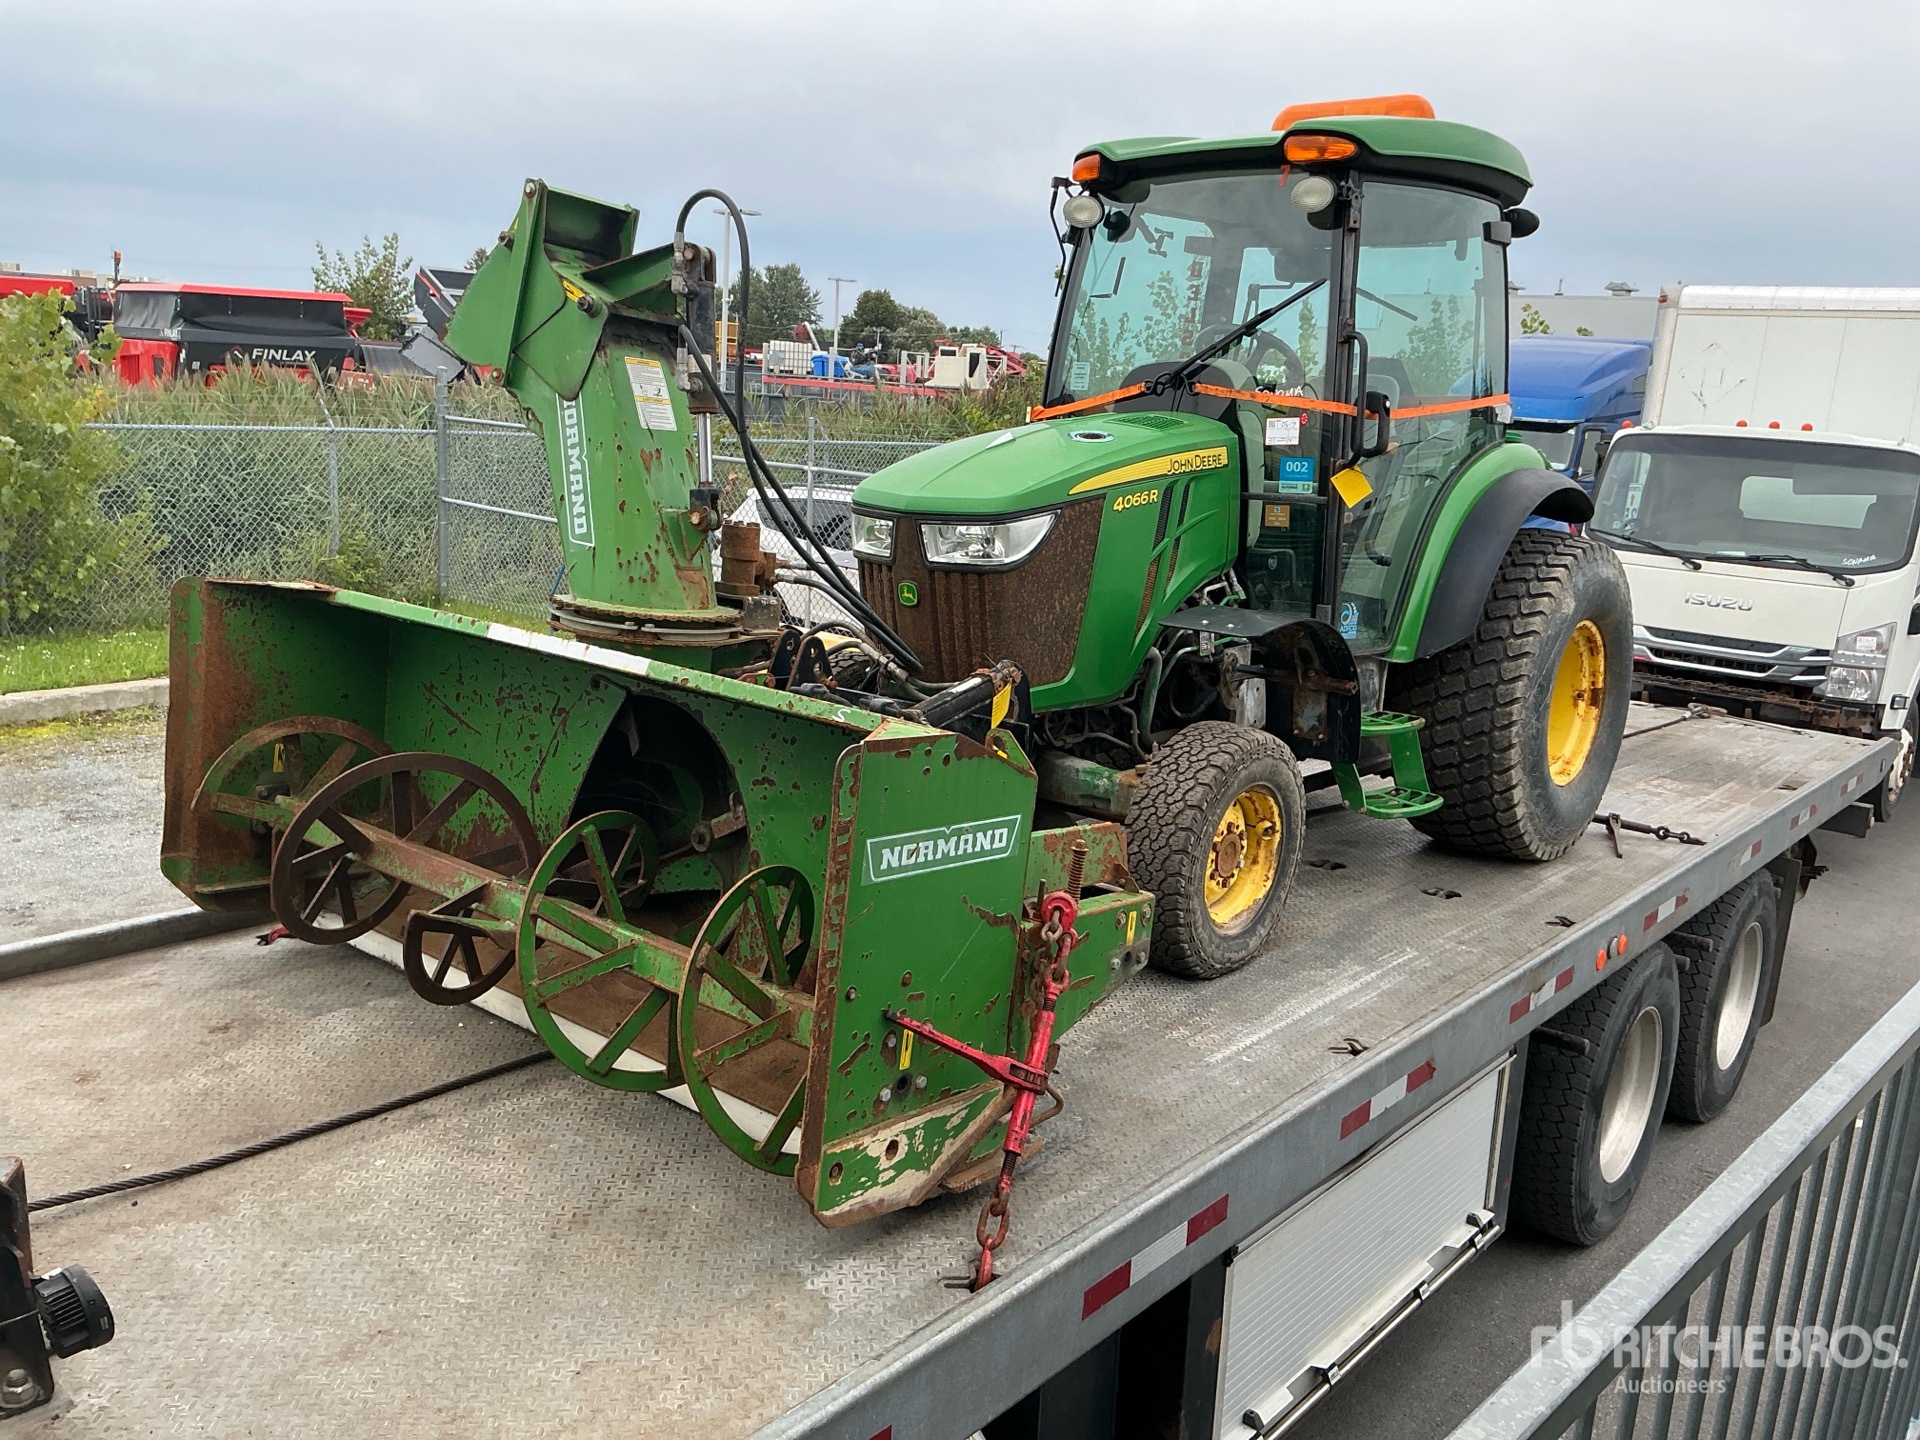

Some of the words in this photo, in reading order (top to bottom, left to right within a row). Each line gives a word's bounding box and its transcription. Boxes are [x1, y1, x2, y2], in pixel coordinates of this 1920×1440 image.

[251, 347, 317, 362] FINLAY
[1167, 456, 1194, 474] JOHN
[1194, 453, 1223, 469] DEERE
[1285, 461, 1309, 473] 002
[1113, 489, 1159, 512] 4066R
[1684, 592, 1754, 612] ISUZU
[880, 827, 1009, 871] NORMAND
